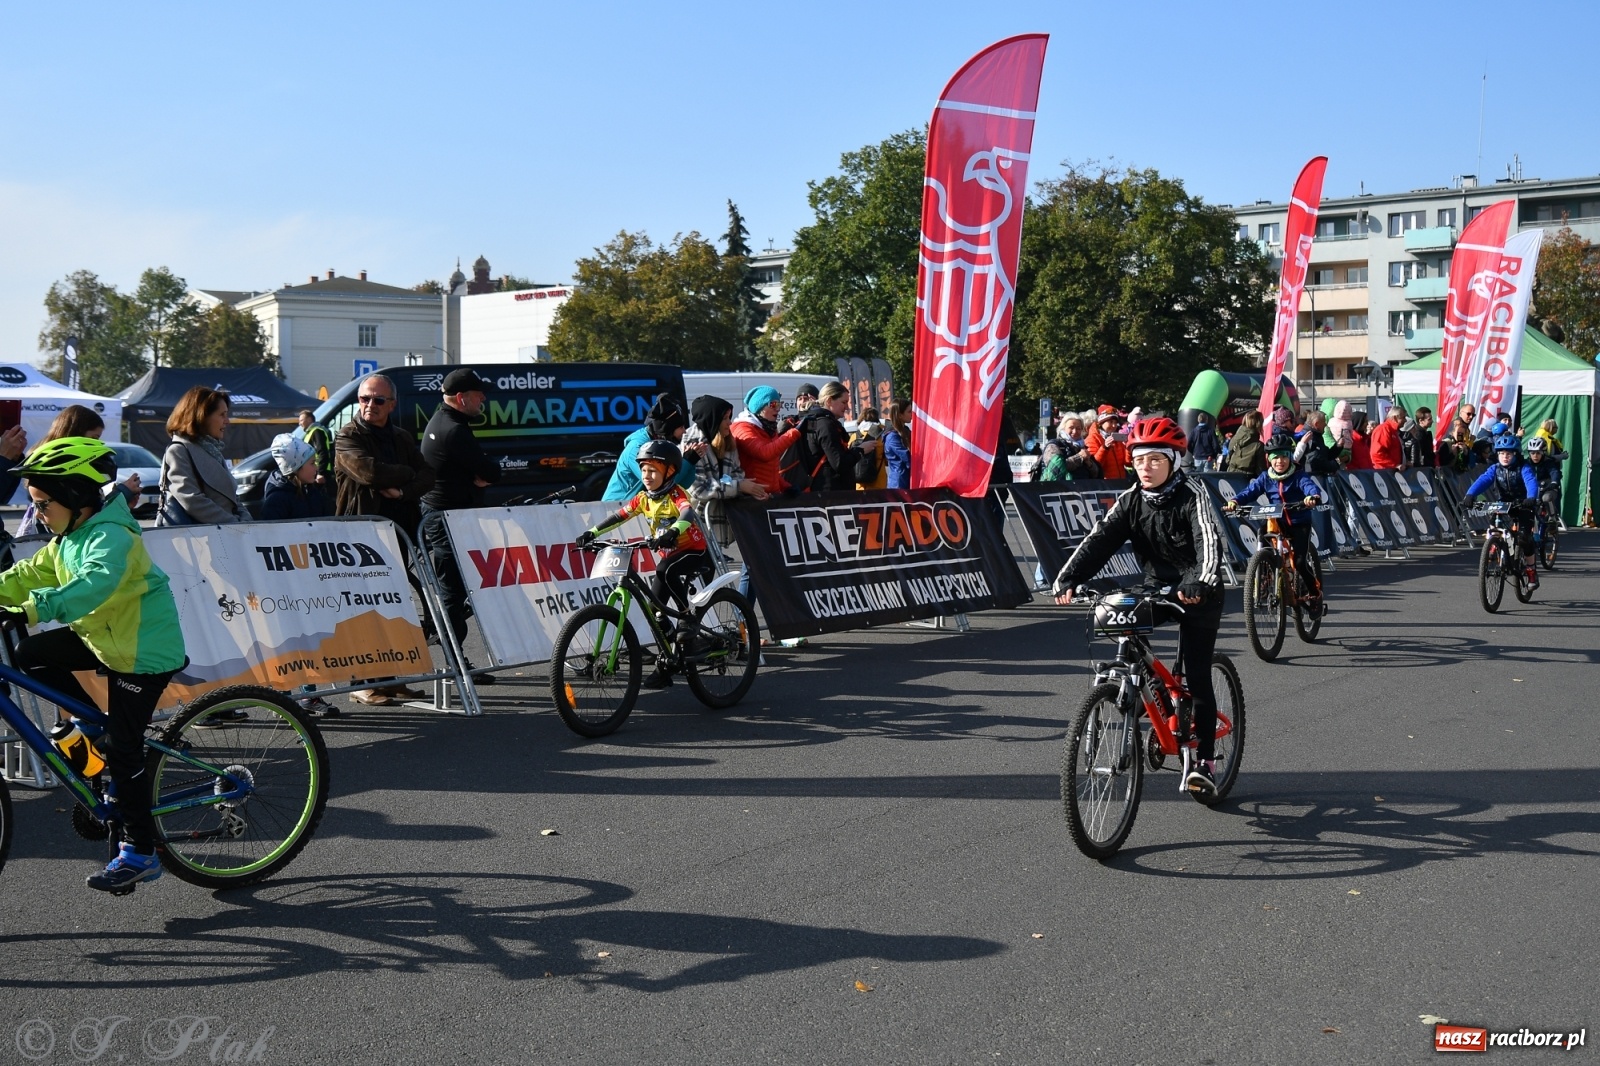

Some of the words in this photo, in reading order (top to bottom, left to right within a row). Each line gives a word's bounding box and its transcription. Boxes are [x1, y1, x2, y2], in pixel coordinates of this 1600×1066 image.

[497, 372, 555, 389] atelier
[415, 395, 656, 428] MBMARATON
[1042, 403, 1049, 415] P
[540, 457, 567, 465] CST
[770, 502, 970, 564] TREZADO
[255, 542, 356, 571] TAURUS
[318, 571, 361, 581] gdziekolwiek
[361, 570, 390, 580] jedziesz
[535, 590, 580, 618] TAKE
[804, 580, 907, 619] USZCZELNIAMY
[906, 571, 992, 606] NAJLEPSZYCH
[1106, 611, 1137, 625] 266
[322, 647, 421, 669] taurus.info.pl
